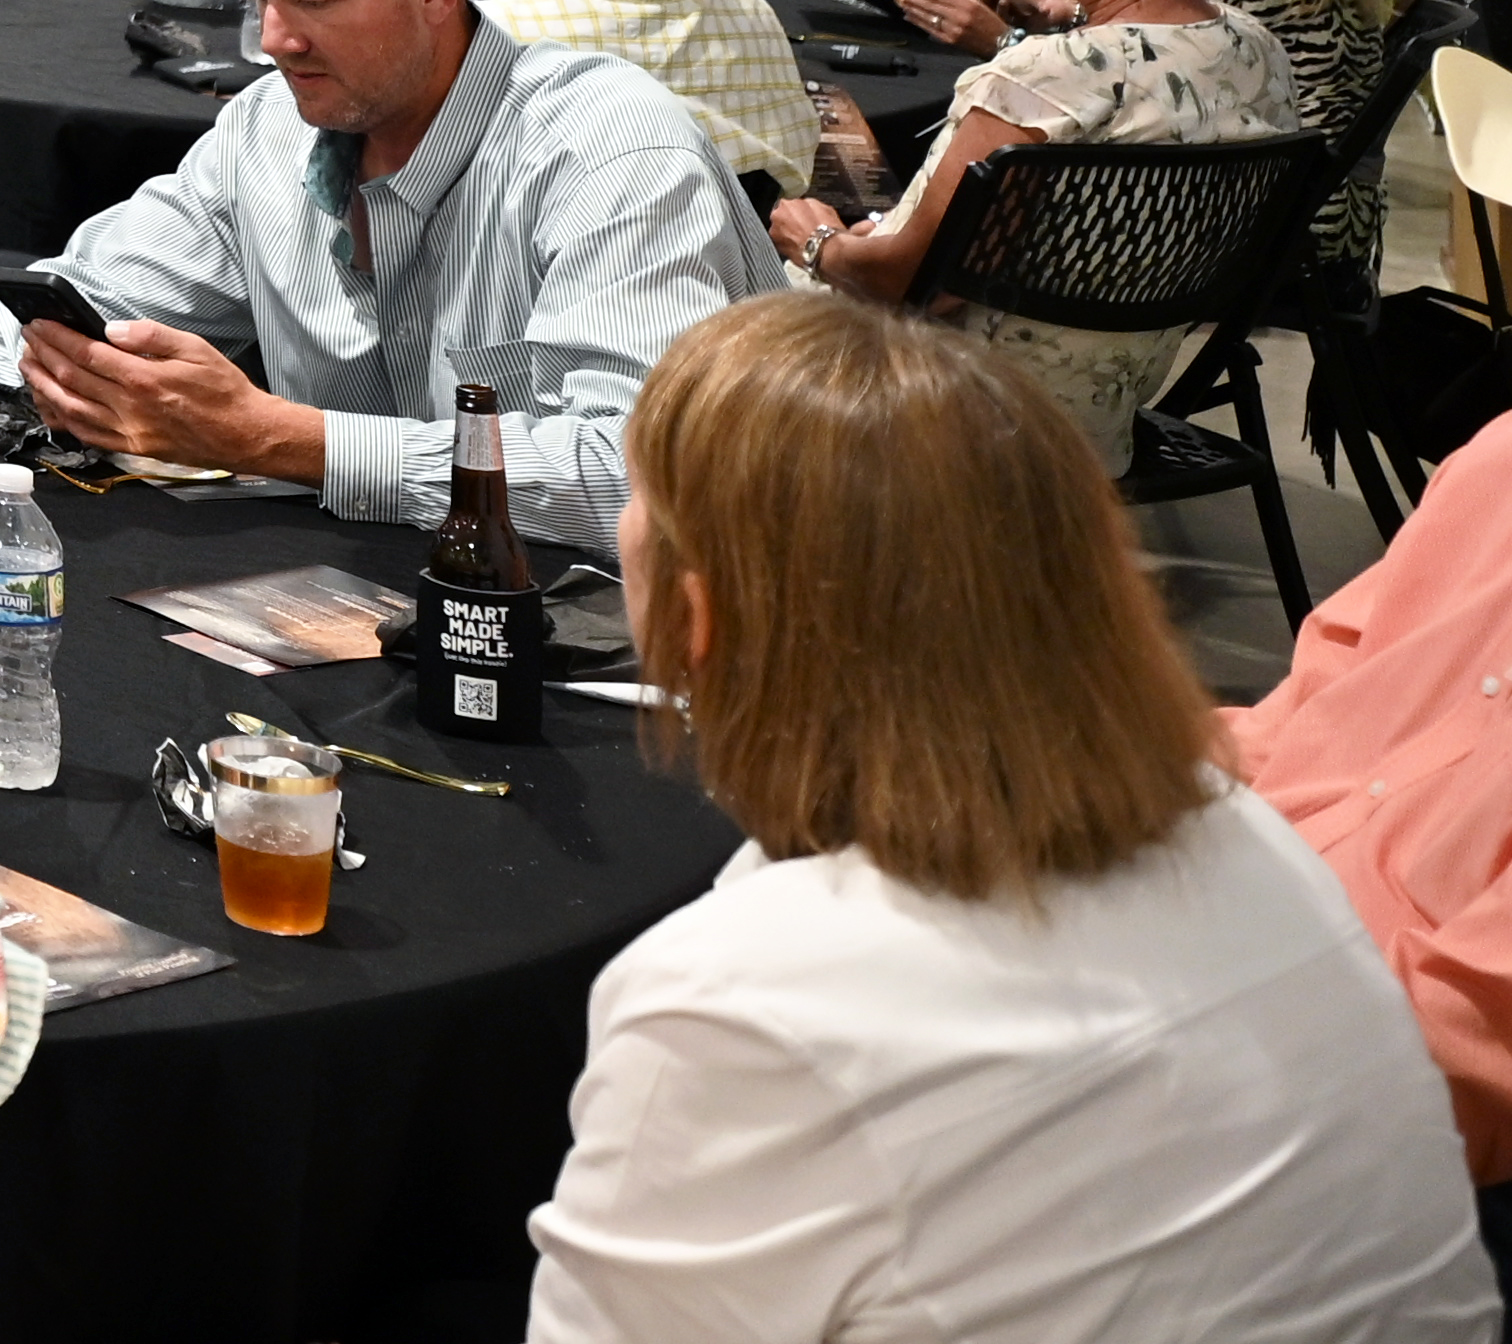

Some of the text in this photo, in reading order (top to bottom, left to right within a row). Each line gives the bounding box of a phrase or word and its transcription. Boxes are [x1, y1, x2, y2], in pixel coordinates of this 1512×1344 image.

[443, 599, 509, 623] SMART
[449, 617, 504, 640] MADE
[440, 632, 514, 658] SIMPLE.
